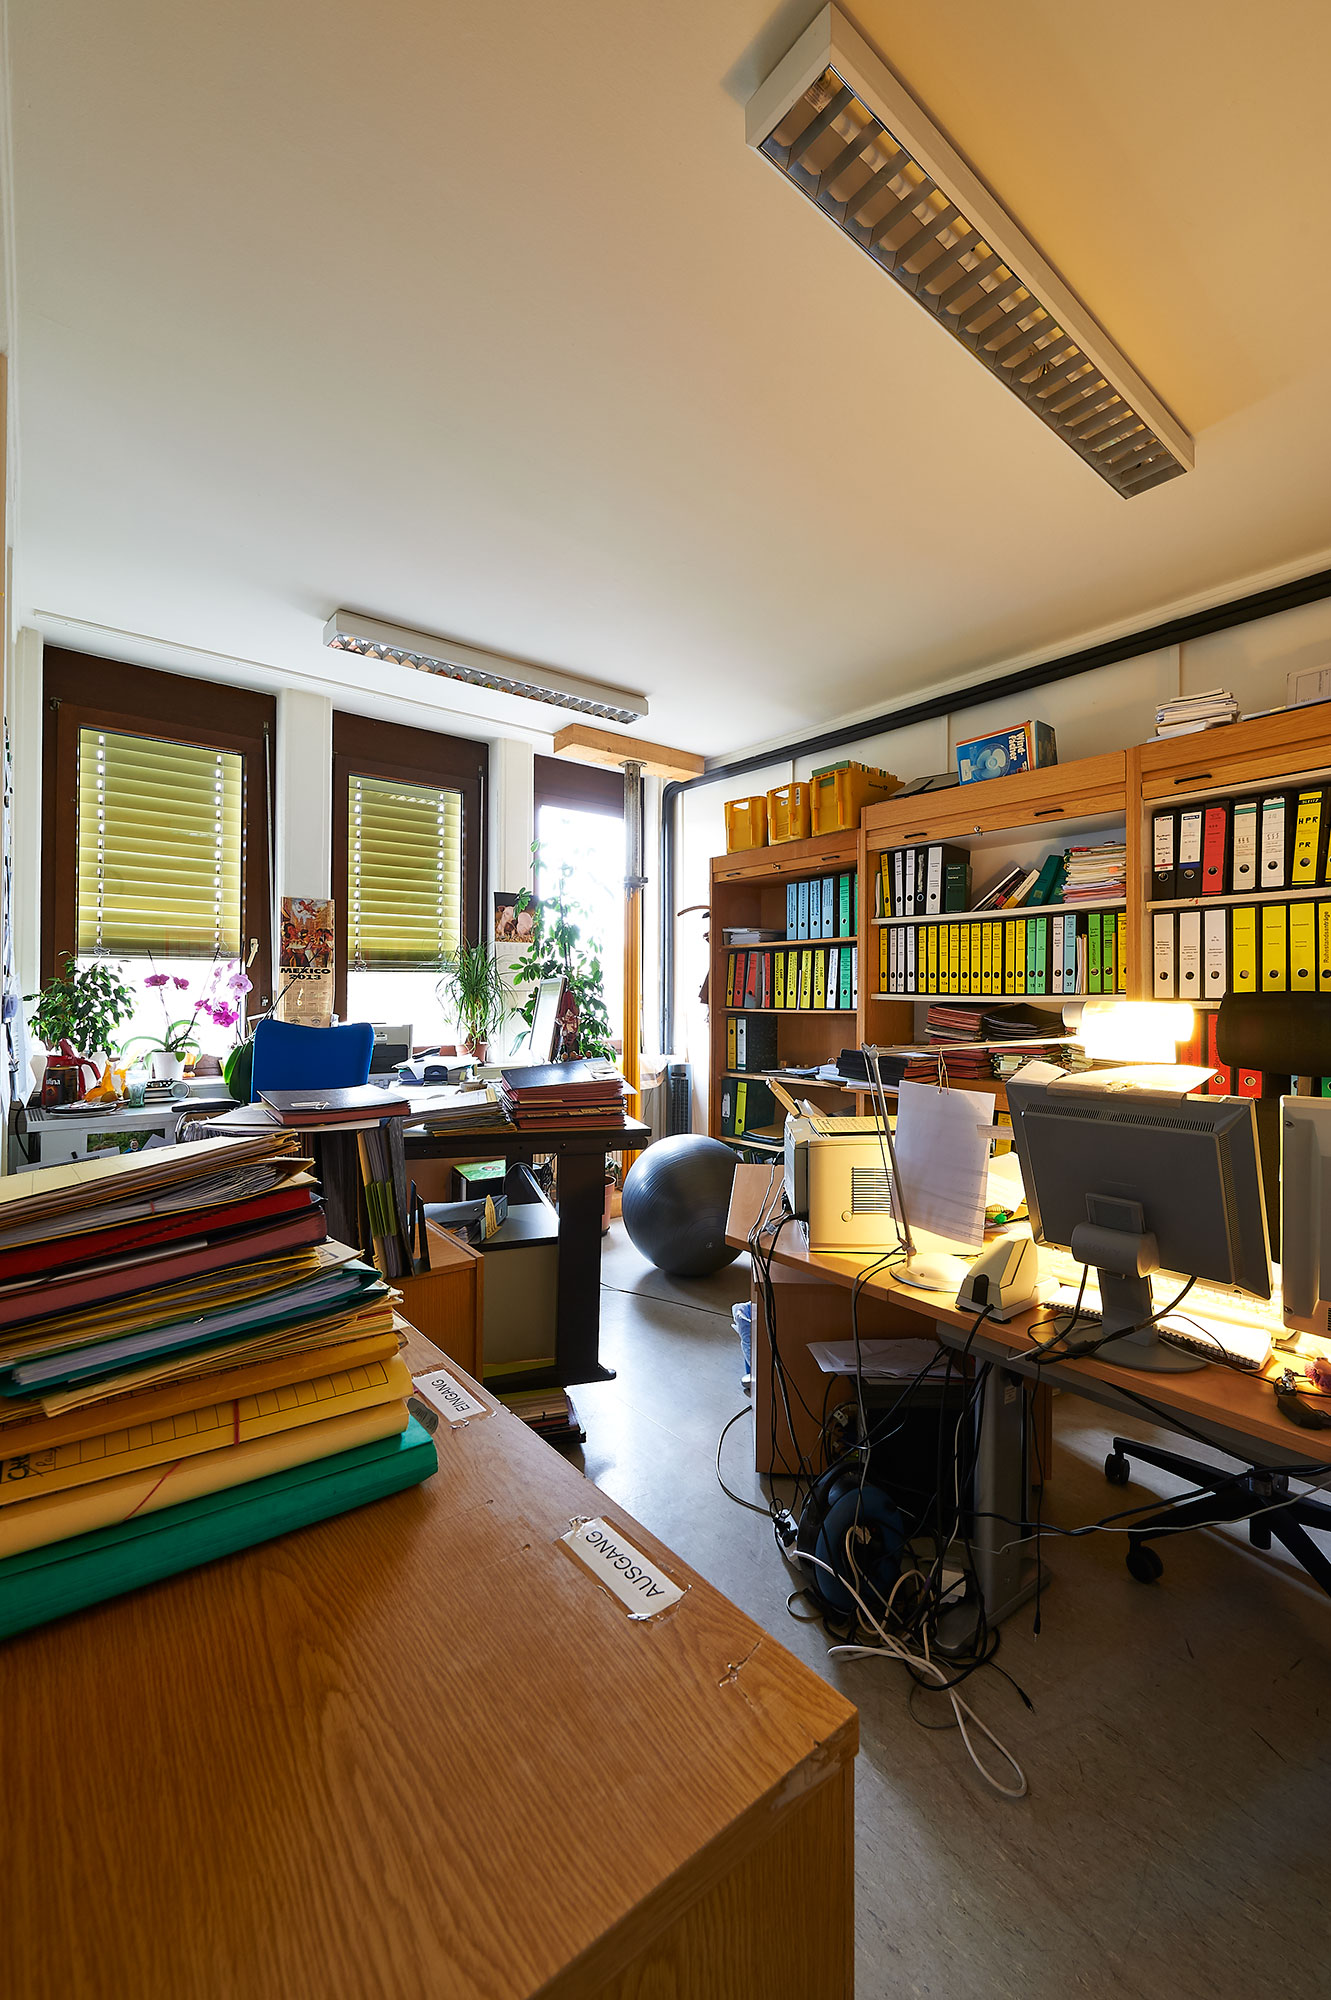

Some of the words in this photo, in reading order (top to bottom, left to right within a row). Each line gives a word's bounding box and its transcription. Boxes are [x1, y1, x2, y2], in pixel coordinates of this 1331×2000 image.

[1299, 816, 1318, 824] HPR
[432, 1379, 470, 1412] EINGANG
[586, 1531, 665, 1597] AUSGANG
